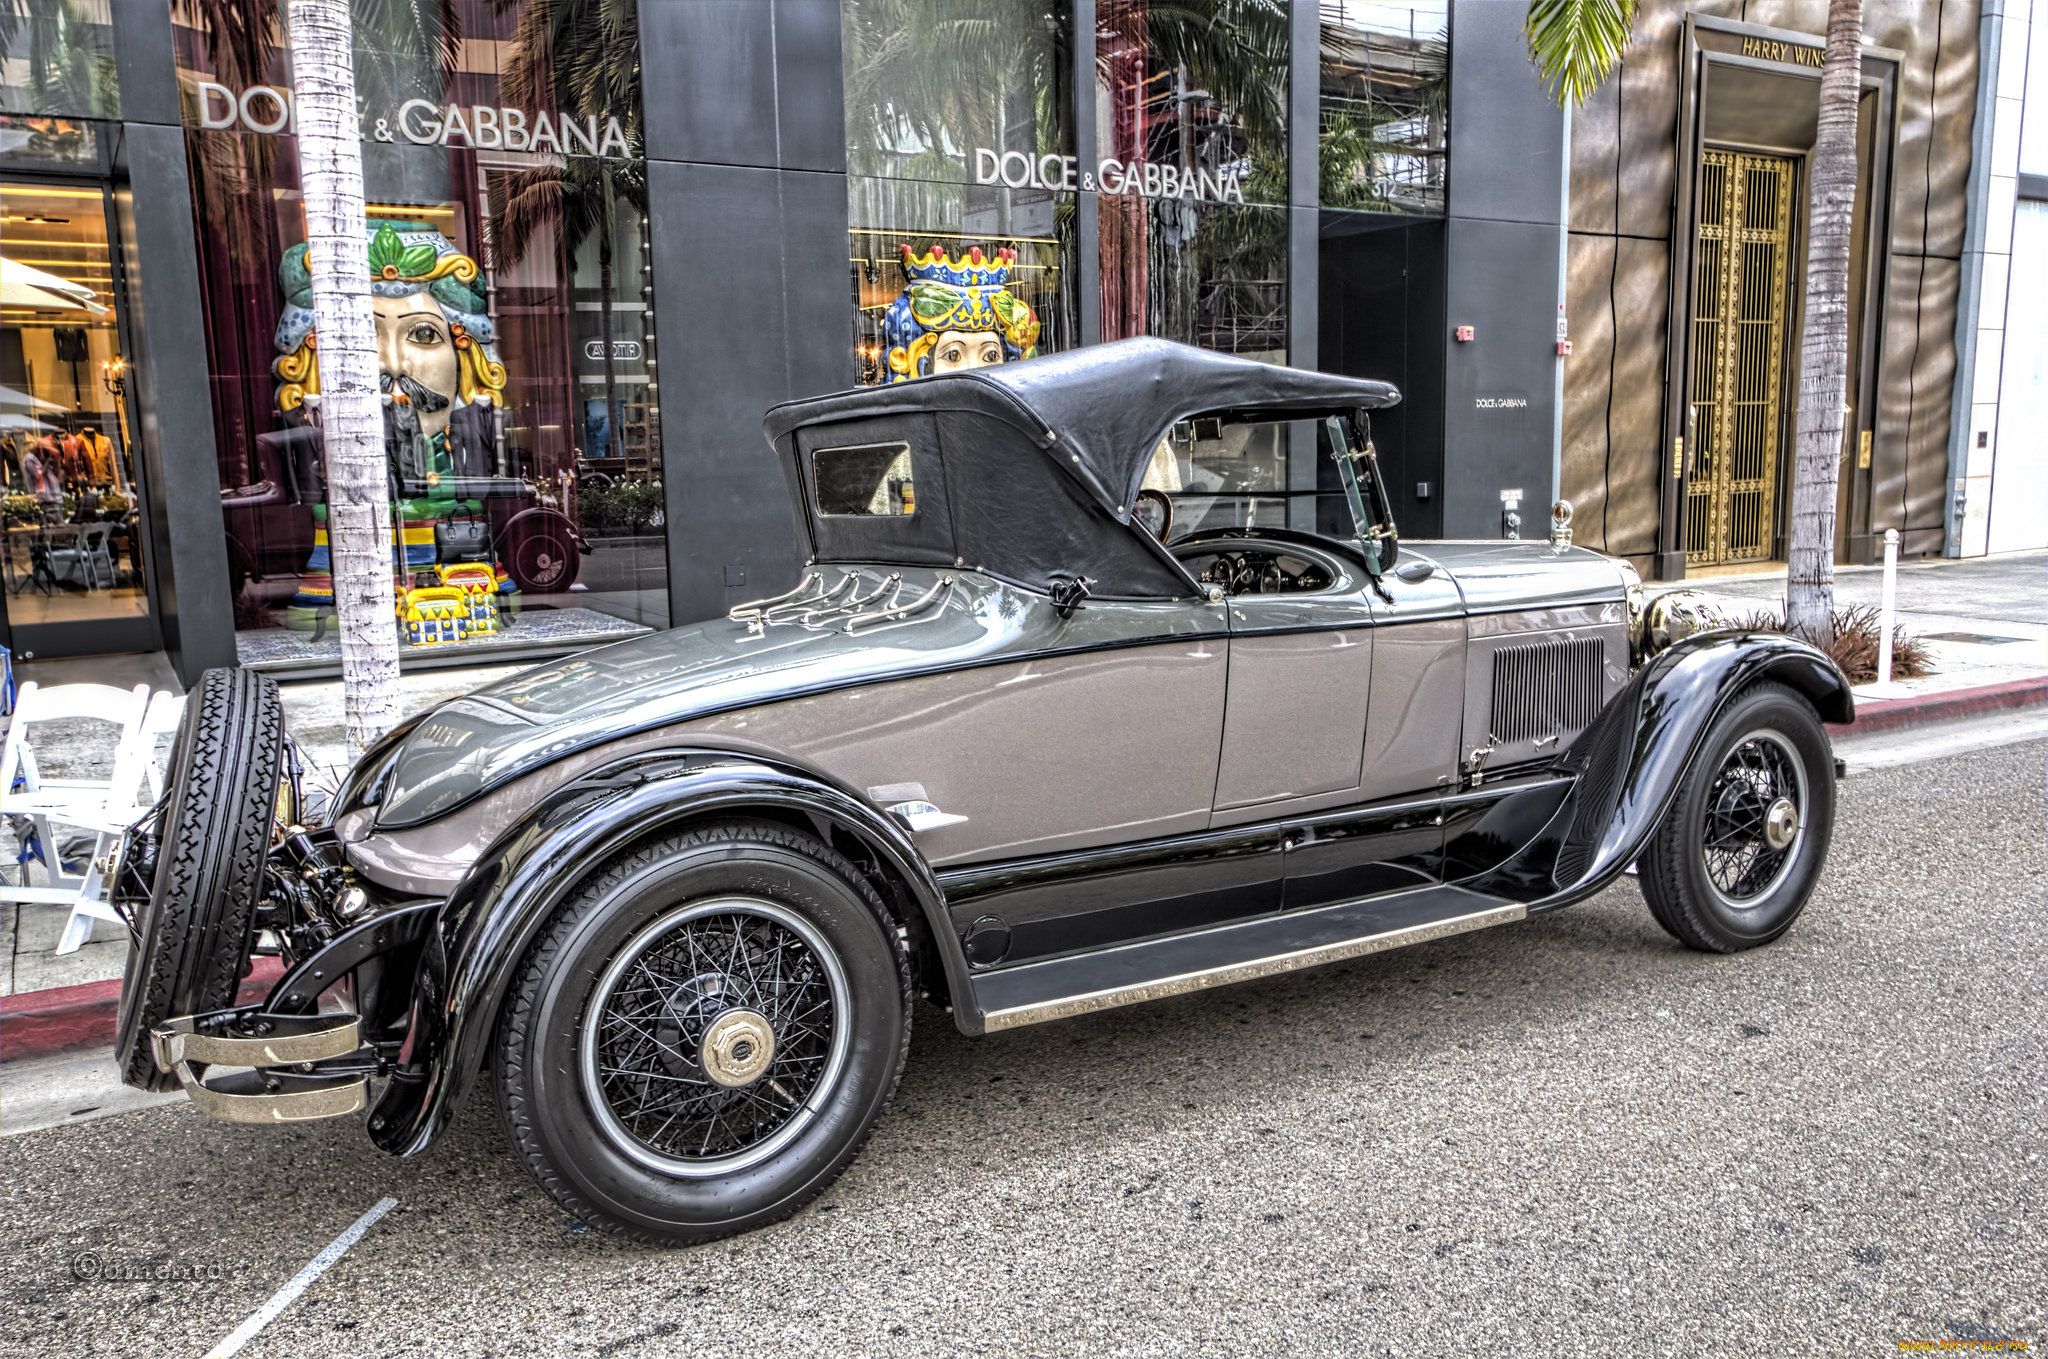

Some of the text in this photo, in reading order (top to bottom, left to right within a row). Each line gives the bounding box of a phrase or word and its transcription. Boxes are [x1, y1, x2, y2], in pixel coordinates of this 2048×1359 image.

[1742, 36, 1826, 68] HARRY WINS
[374, 118, 394, 144] &
[398, 98, 633, 159] GABBANA
[975, 148, 1244, 204] DOLCE & GABBANA
[1371, 178, 1397, 198] 312
[1476, 398, 1495, 408] DOLCE
[1498, 398, 1527, 408] GABBANA
